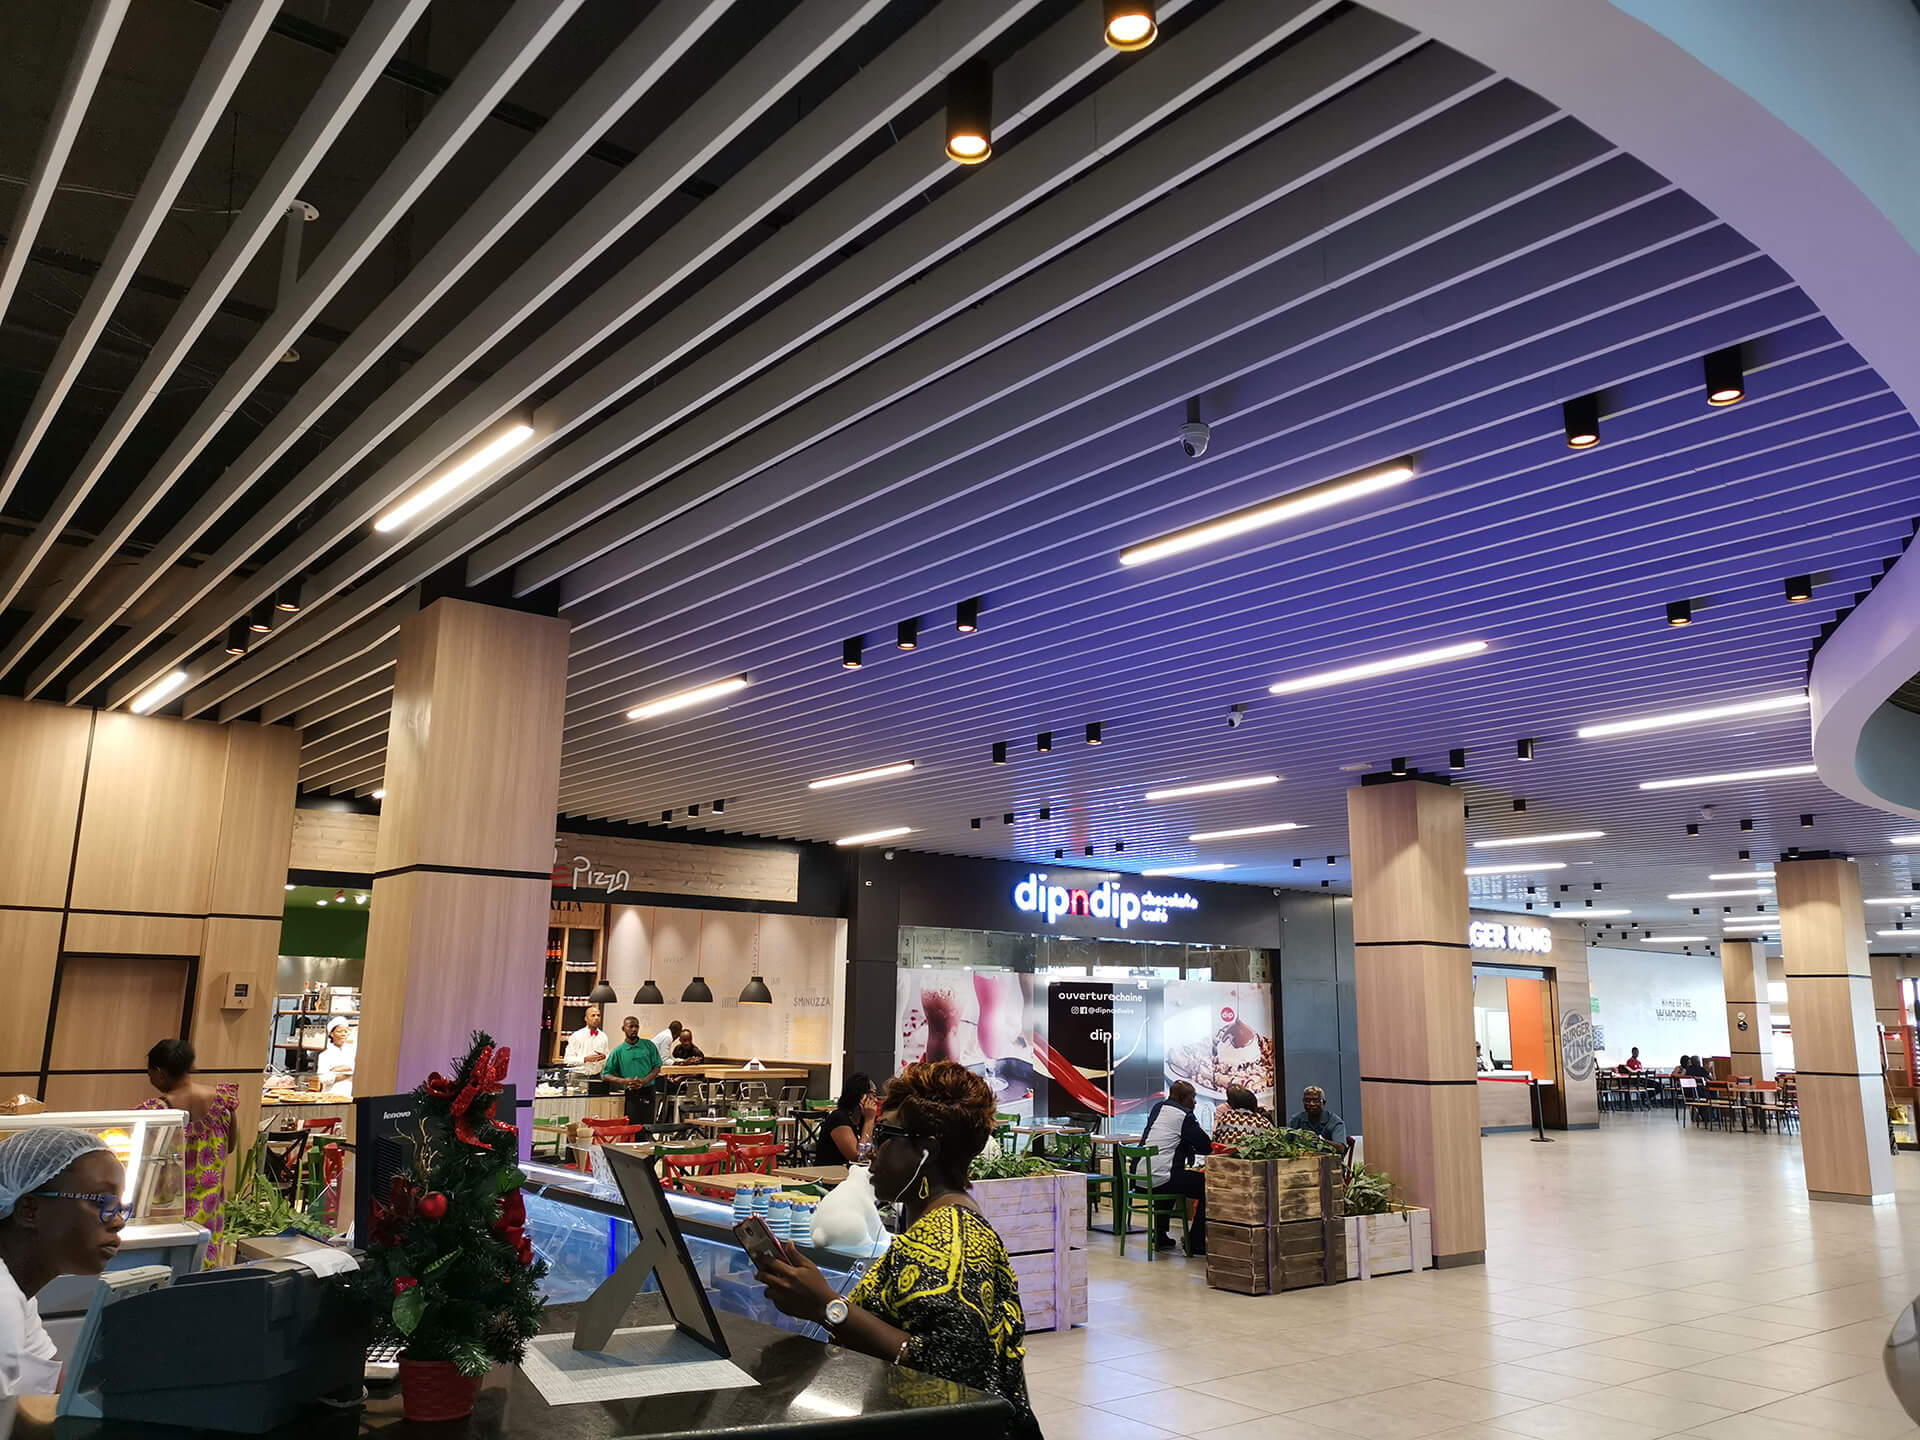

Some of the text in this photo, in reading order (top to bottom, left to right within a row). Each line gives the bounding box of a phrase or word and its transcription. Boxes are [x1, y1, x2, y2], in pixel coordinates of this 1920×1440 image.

[1507, 925, 1552, 953] KING
[1563, 1022, 1591, 1048] BURGER
[1565, 1035, 1592, 1064] KING
